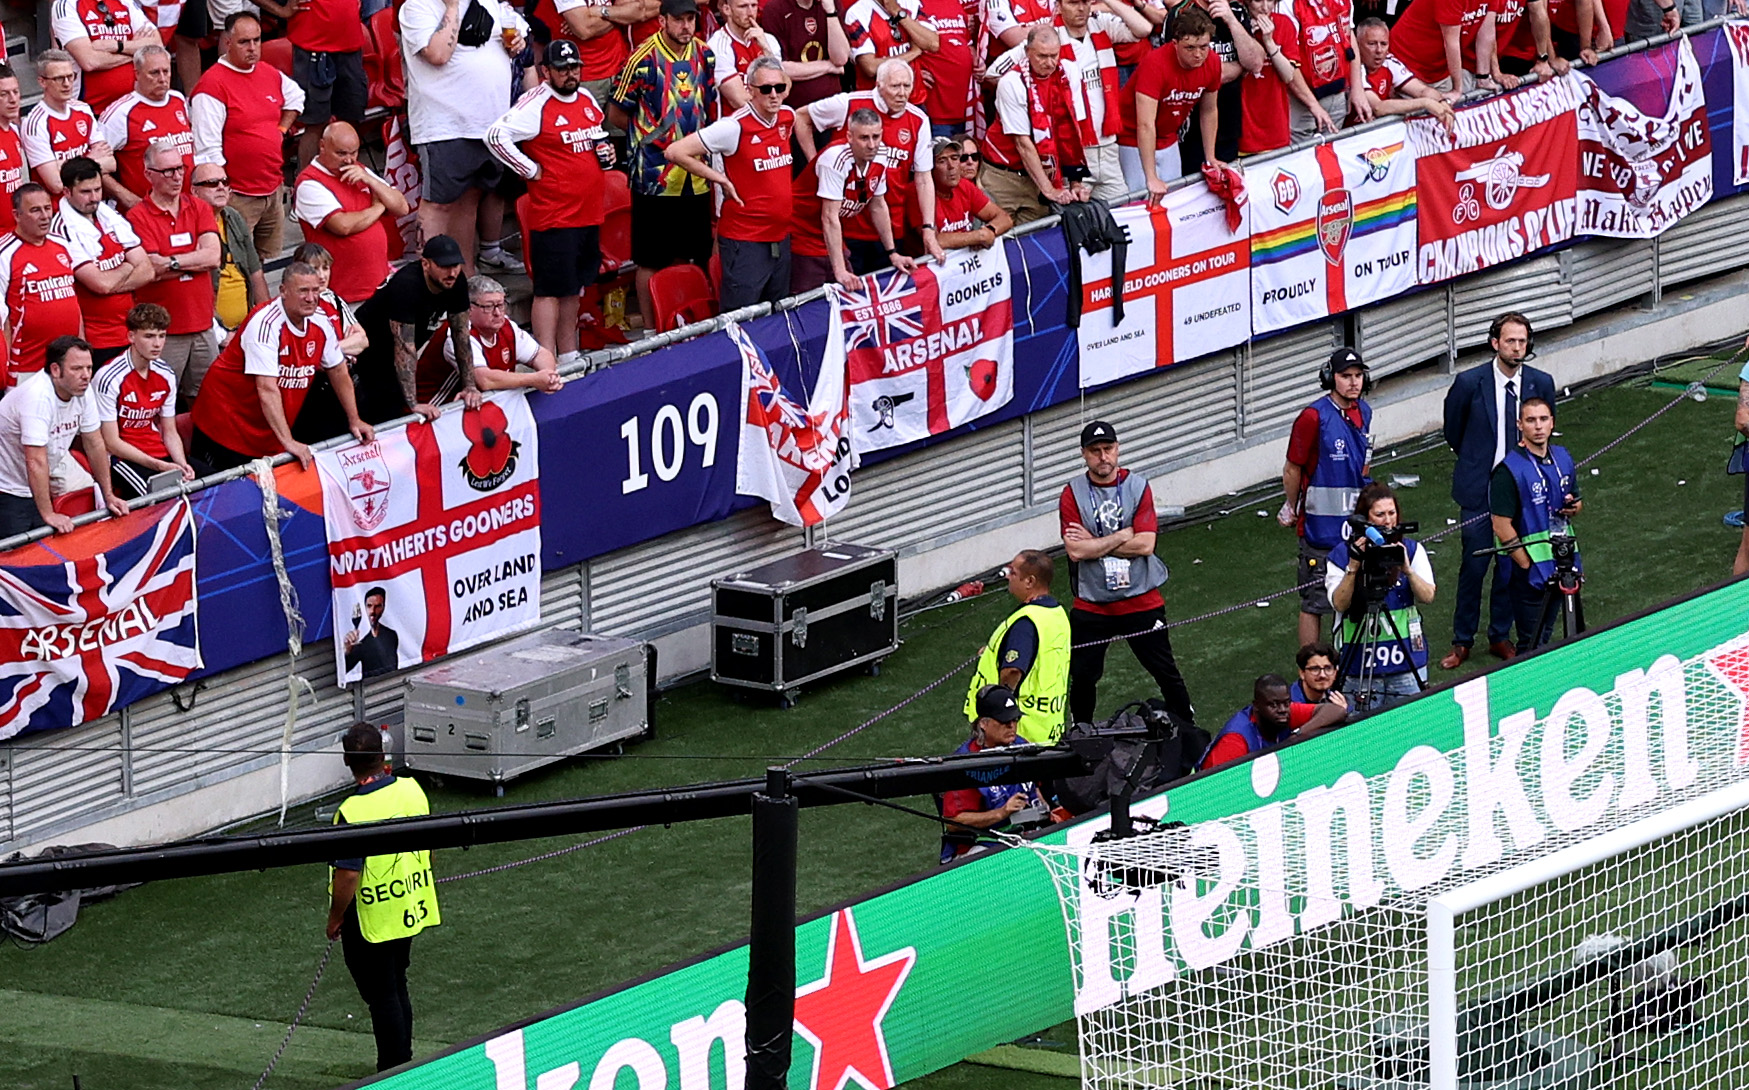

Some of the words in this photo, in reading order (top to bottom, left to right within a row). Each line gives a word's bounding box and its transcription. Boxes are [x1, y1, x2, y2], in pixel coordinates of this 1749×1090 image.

[753, 153, 794, 172] Emirates
[1740, 144, 1749, 179] I
[1320, 202, 1350, 217] Arsenal
[958, 254, 982, 275] THE
[1419, 216, 1524, 284] CHAMPIONS
[1144, 263, 1192, 288] GOONERS
[1192, 259, 1209, 275] ON
[1208, 251, 1236, 271] TOUR
[1262, 277, 1317, 305] PROUDLY
[1354, 260, 1373, 279] ON
[1376, 250, 1411, 273] TOUR
[854, 304, 876, 321] EST
[877, 299, 903, 318] 1886
[1184, 312, 1193, 325] 49
[1193, 302, 1242, 323] UNDEFEATED
[882, 317, 985, 375] ARSENAL
[1103, 336, 1119, 347] LAND
[1120, 332, 1133, 343] AND
[1134, 329, 1145, 338] SEA
[342, 440, 382, 469] Arsenal
[620, 391, 720, 496] 109
[392, 527, 448, 562] HERTS
[450, 493, 535, 543] GOONERS
[453, 568, 493, 599] OVER
[494, 553, 537, 582] LAND
[462, 598, 495, 626] AND
[498, 586, 529, 611] SEA
[20, 596, 161, 662] ARSENAL
[448, 723, 455, 735] 2
